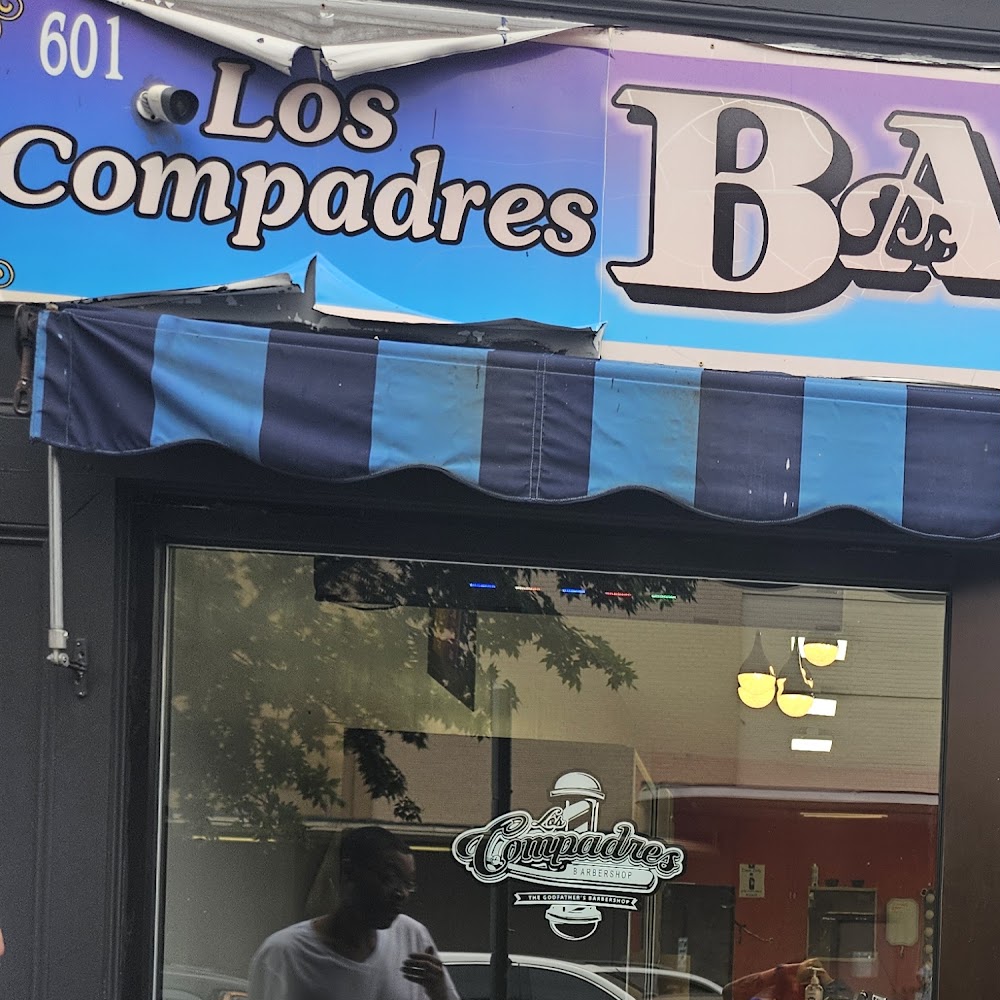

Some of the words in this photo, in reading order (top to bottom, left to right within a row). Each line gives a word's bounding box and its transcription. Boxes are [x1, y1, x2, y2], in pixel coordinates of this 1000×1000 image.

[39, 11, 123, 80] 601
[200, 58, 398, 152] Los
[0, 125, 598, 257] Compadres
[452, 811, 684, 883] Compadres
[532, 806, 566, 829] Los
[573, 866, 632, 880] BARBERSHOP
[588, 895, 631, 905] BARBERSHOP
